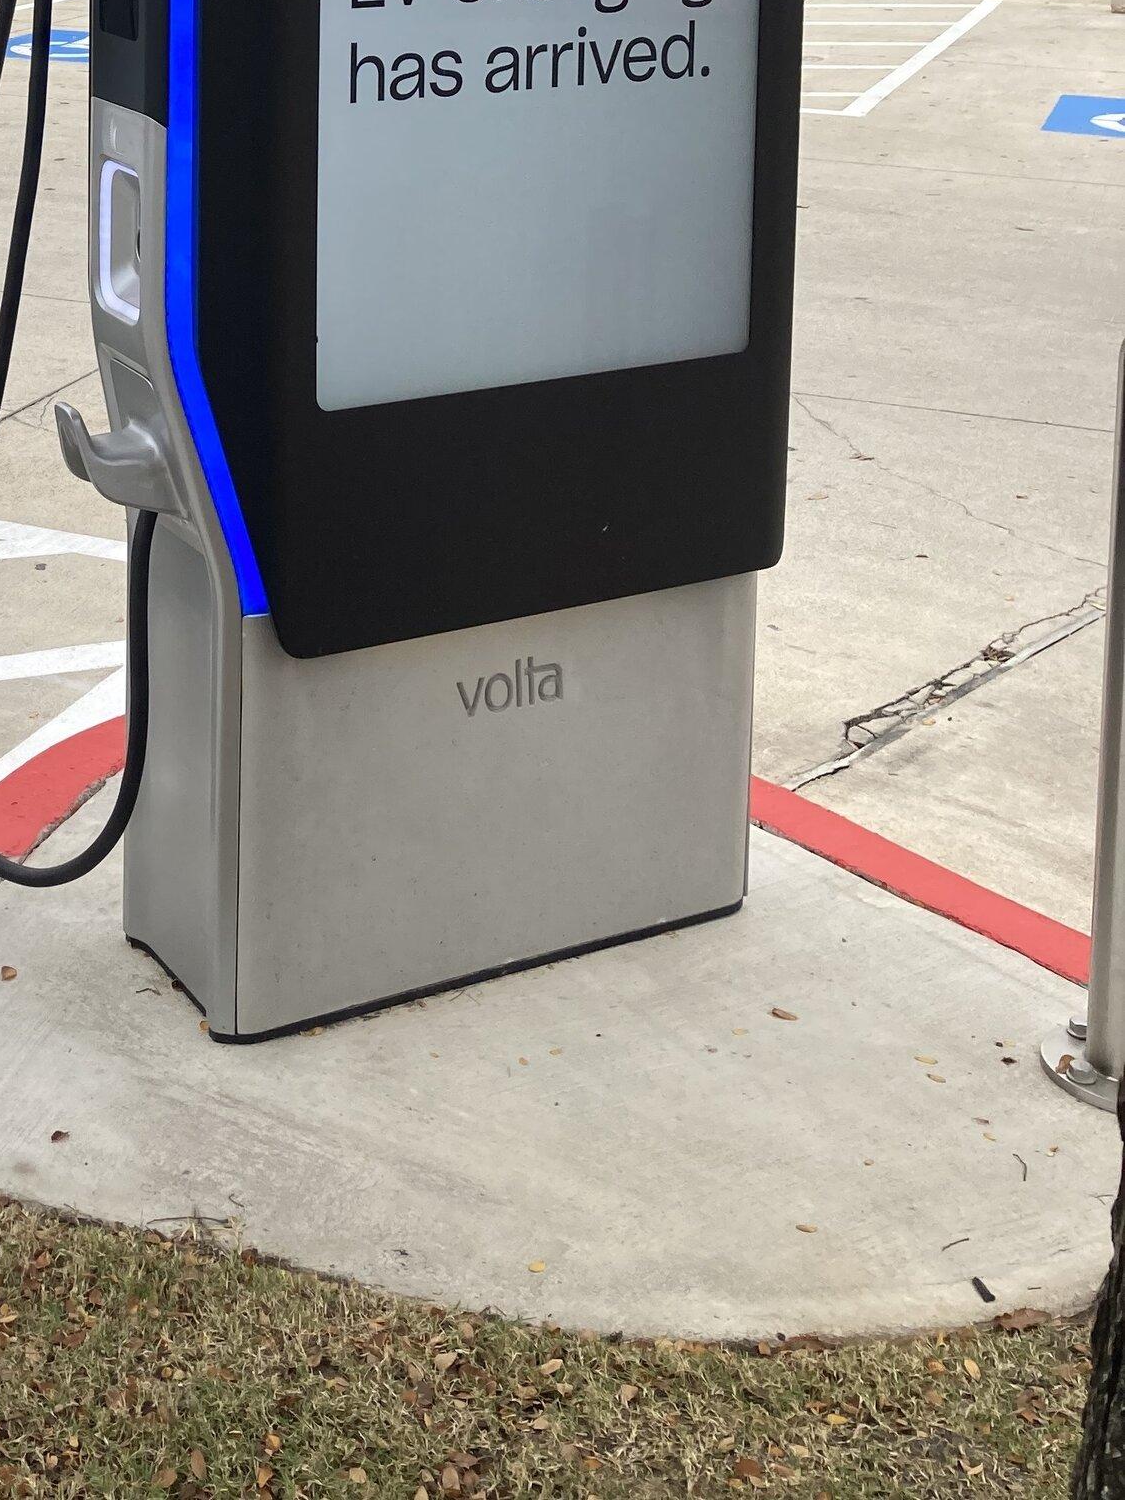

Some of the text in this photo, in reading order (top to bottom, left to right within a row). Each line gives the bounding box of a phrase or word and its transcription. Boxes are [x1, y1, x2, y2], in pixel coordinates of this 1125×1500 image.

[349, 19, 711, 104] has arrived.
[456, 656, 564, 718] volta
